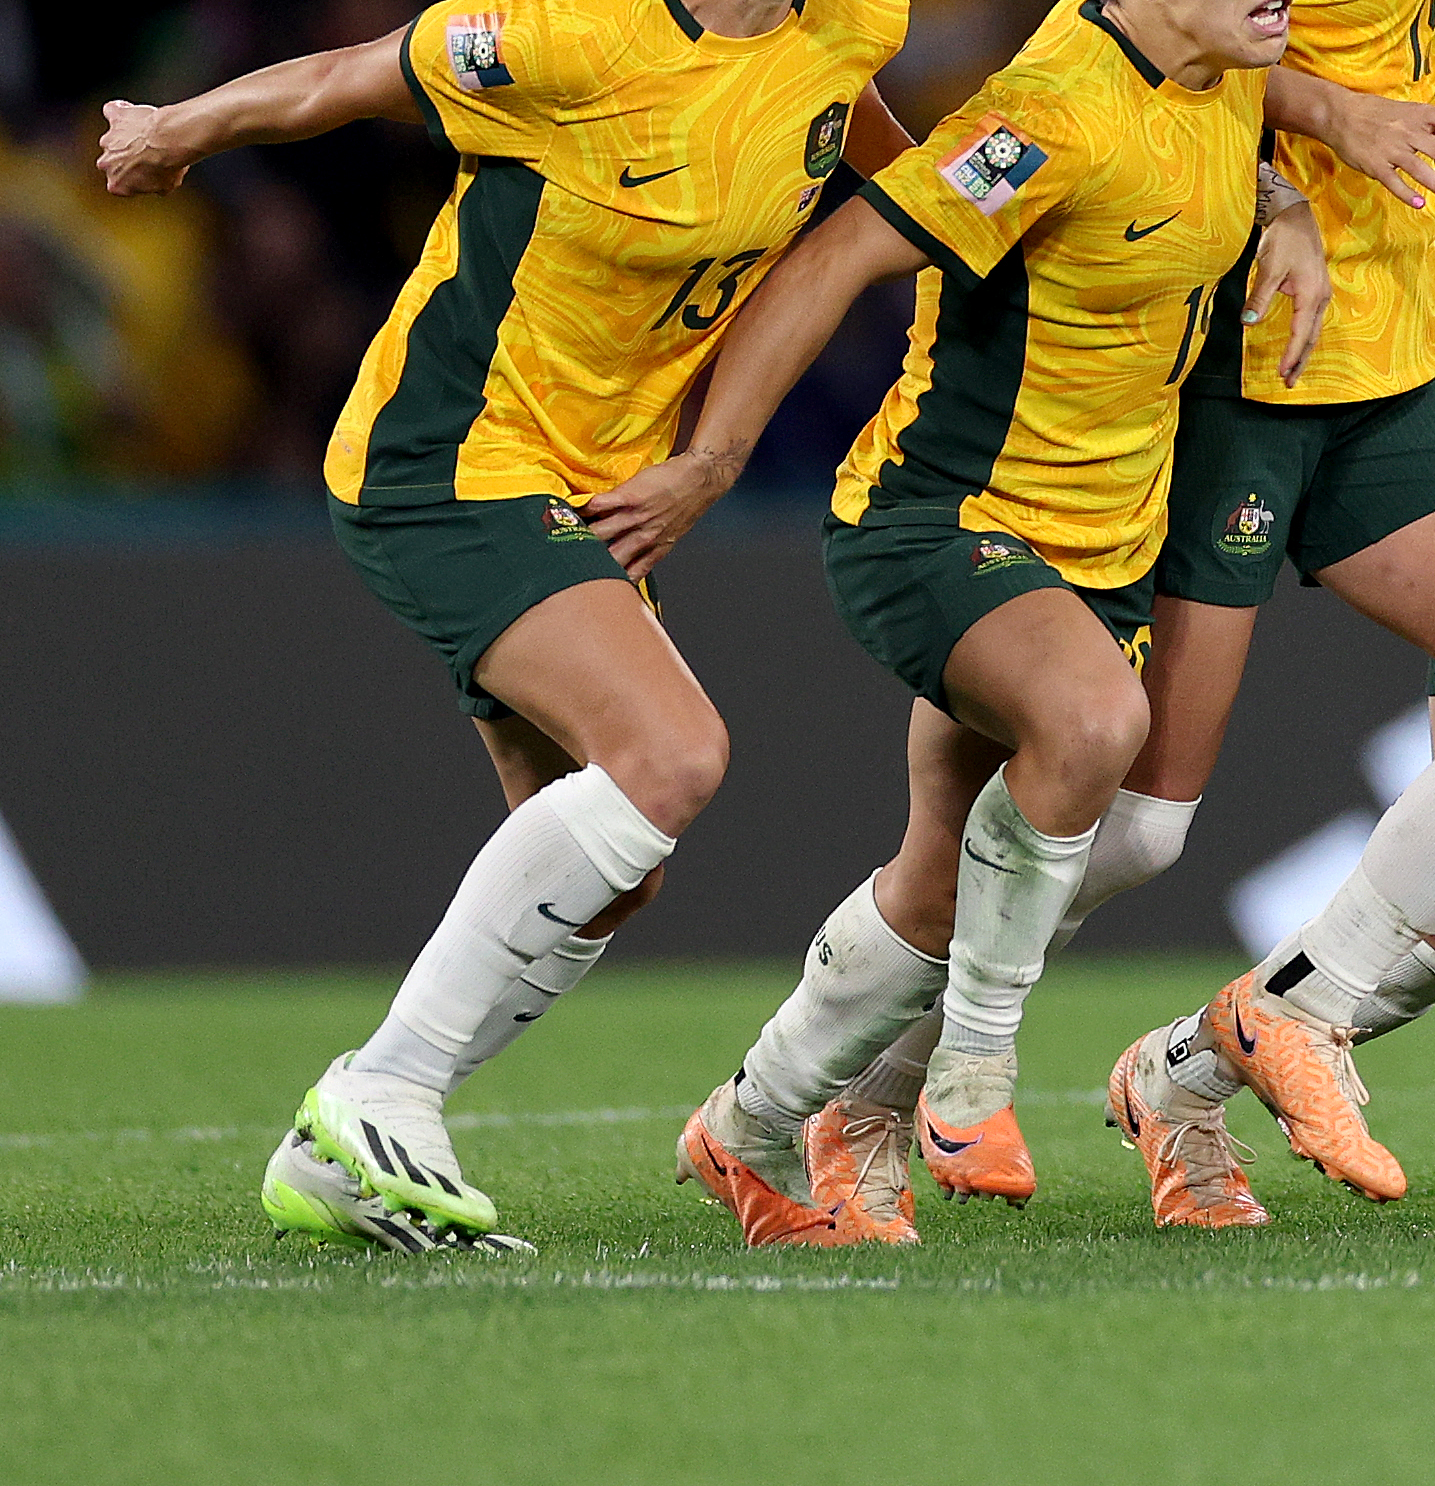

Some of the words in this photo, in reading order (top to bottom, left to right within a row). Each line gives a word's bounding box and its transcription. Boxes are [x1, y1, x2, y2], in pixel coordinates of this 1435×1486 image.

[650, 247, 769, 331] 13
[1223, 534, 1268, 544] AUSTRALIA
[815, 925, 833, 966] US
